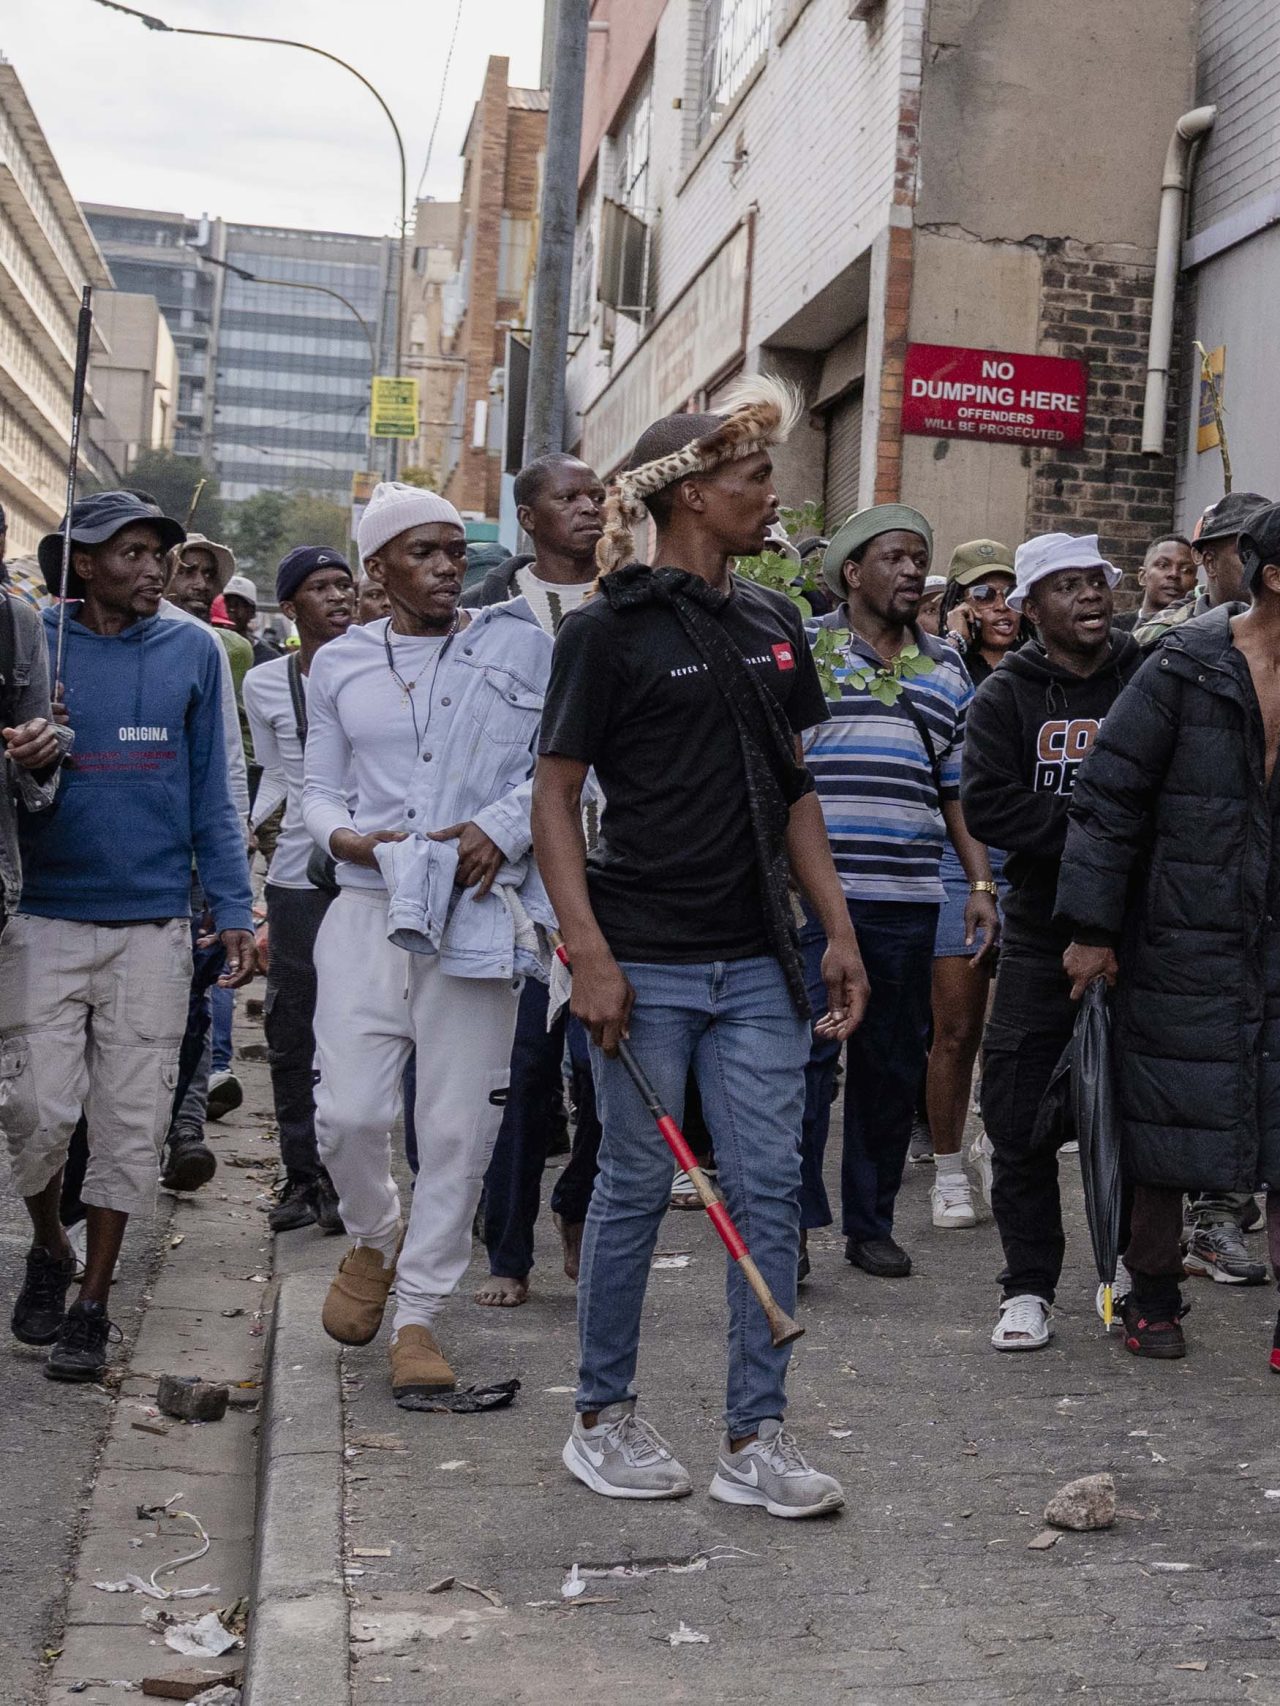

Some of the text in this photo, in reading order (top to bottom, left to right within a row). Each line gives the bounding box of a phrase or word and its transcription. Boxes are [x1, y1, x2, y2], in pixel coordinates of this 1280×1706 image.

[981, 360, 1015, 380] NO
[911, 378, 1080, 413] DUMPING HERE
[957, 407, 1035, 424] OFFENDERS
[924, 417, 1065, 441] WILL BE PROSECUTED
[670, 665, 698, 677] NEVER
[118, 726, 169, 742] ORIGINA
[1036, 718, 1105, 763] CO
